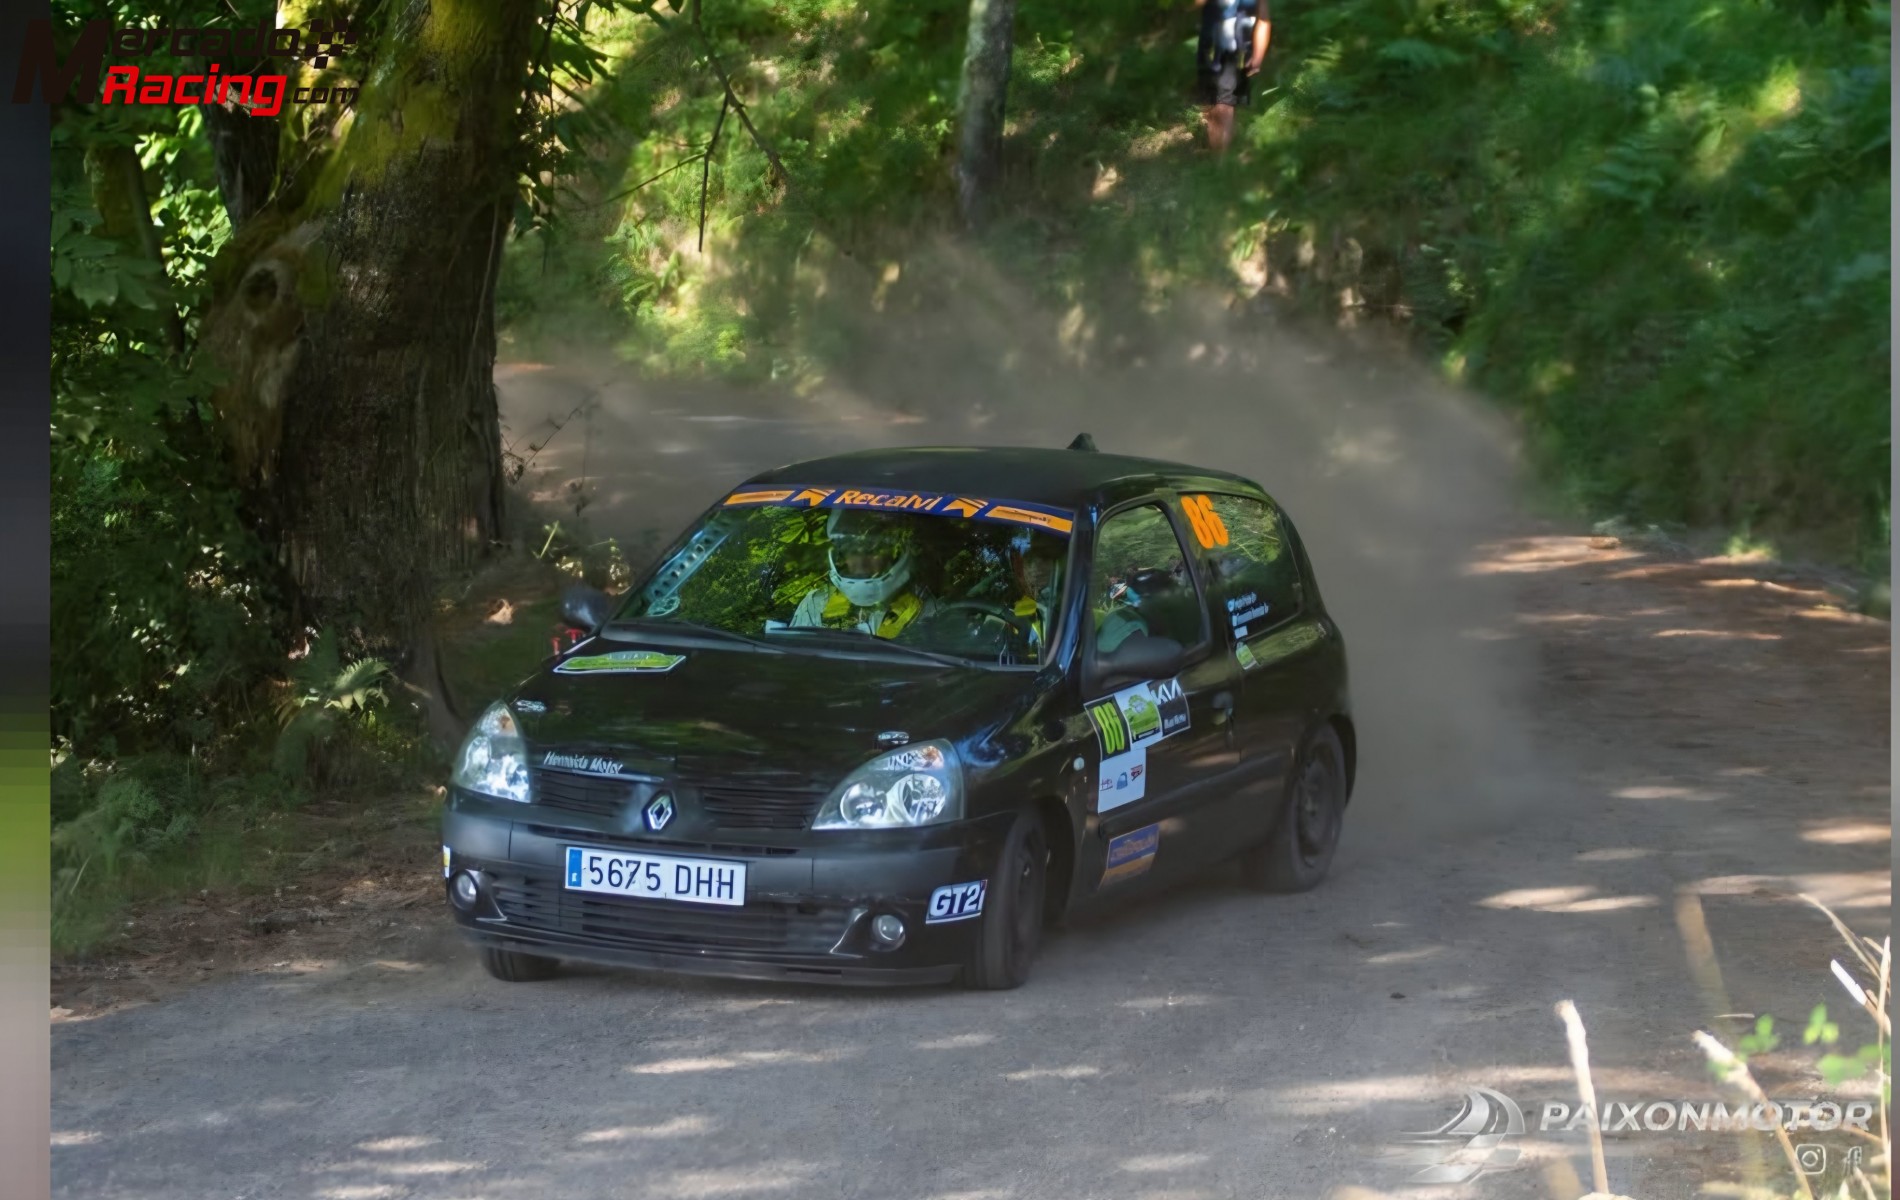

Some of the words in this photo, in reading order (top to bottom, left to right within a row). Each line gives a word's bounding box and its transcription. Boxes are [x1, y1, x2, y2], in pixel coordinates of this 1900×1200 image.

[833, 489, 943, 511] Recalvi
[1181, 494, 1229, 549] 86
[589, 856, 661, 892] 5675
[674, 864, 735, 900] DHH
